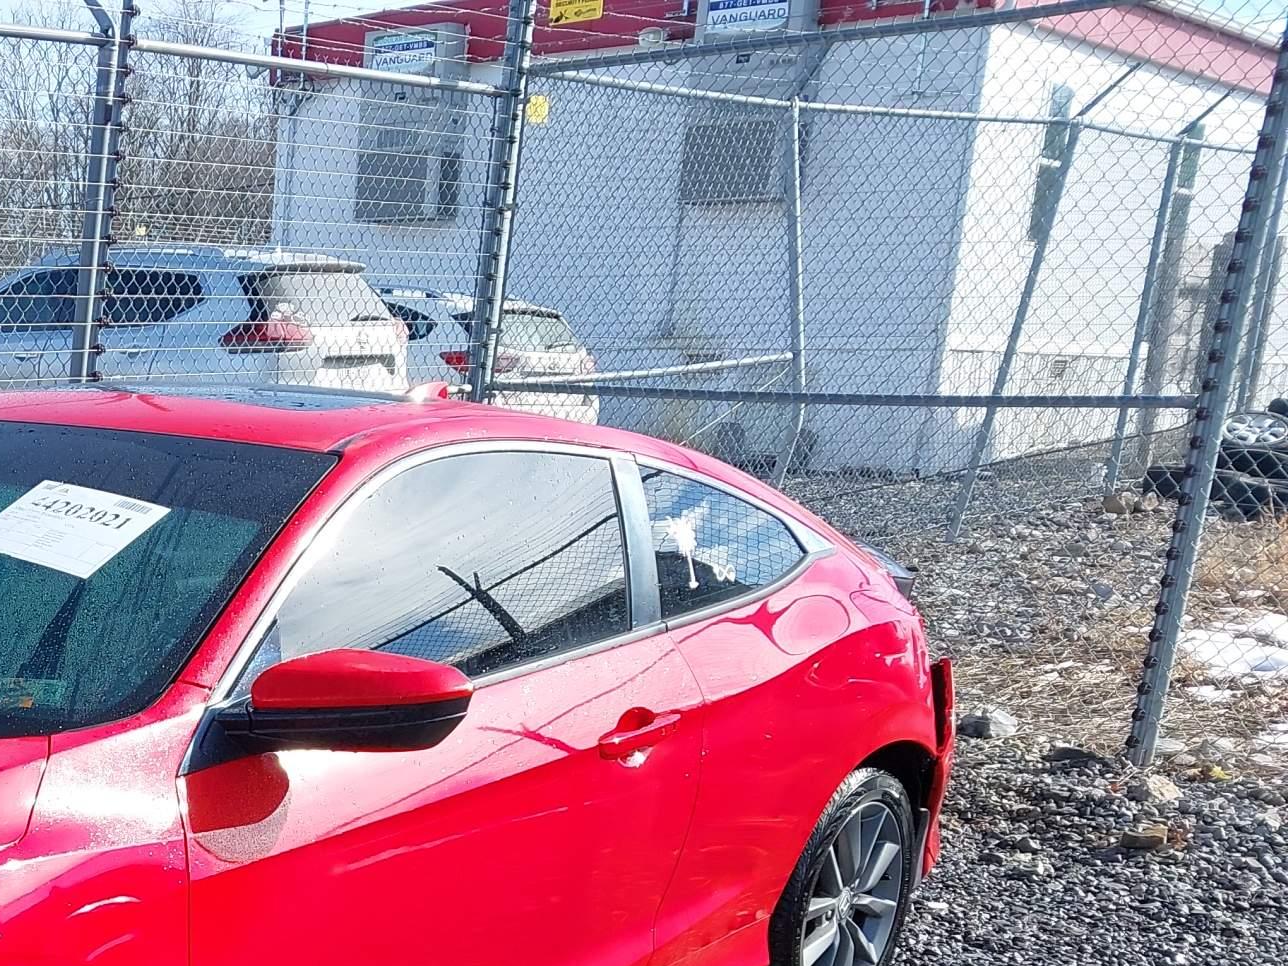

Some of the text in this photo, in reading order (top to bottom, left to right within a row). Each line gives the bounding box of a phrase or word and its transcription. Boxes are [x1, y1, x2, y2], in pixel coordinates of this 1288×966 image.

[711, 7, 786, 25] VANGUARD
[375, 52, 433, 68] VANGUARD
[31, 497, 132, 529] 44202021
